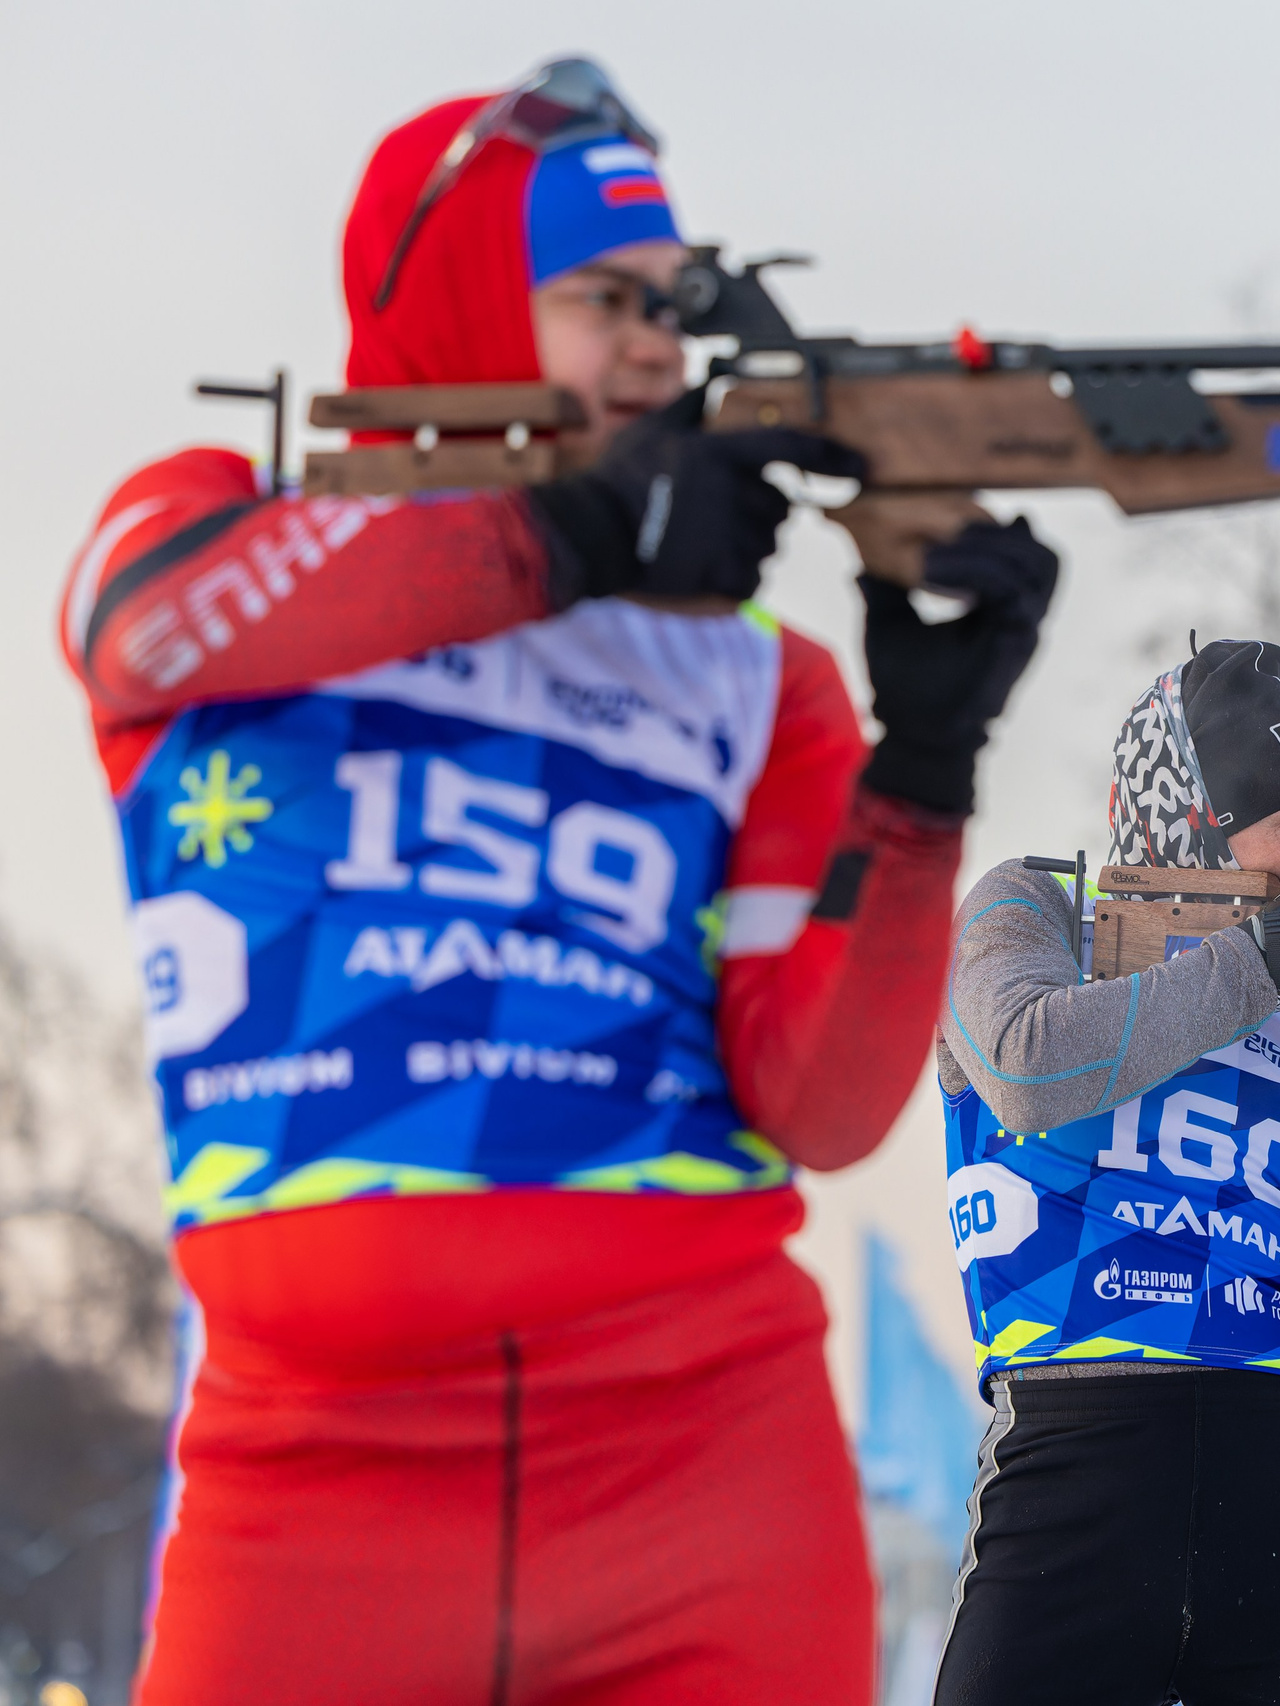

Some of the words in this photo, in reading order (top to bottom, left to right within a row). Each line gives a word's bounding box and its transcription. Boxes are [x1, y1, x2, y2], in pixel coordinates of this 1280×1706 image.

[324, 749, 679, 955] 159
[949, 1189, 997, 1251] 160
[1124, 1269, 1193, 1290] ГАЗПРОМ
